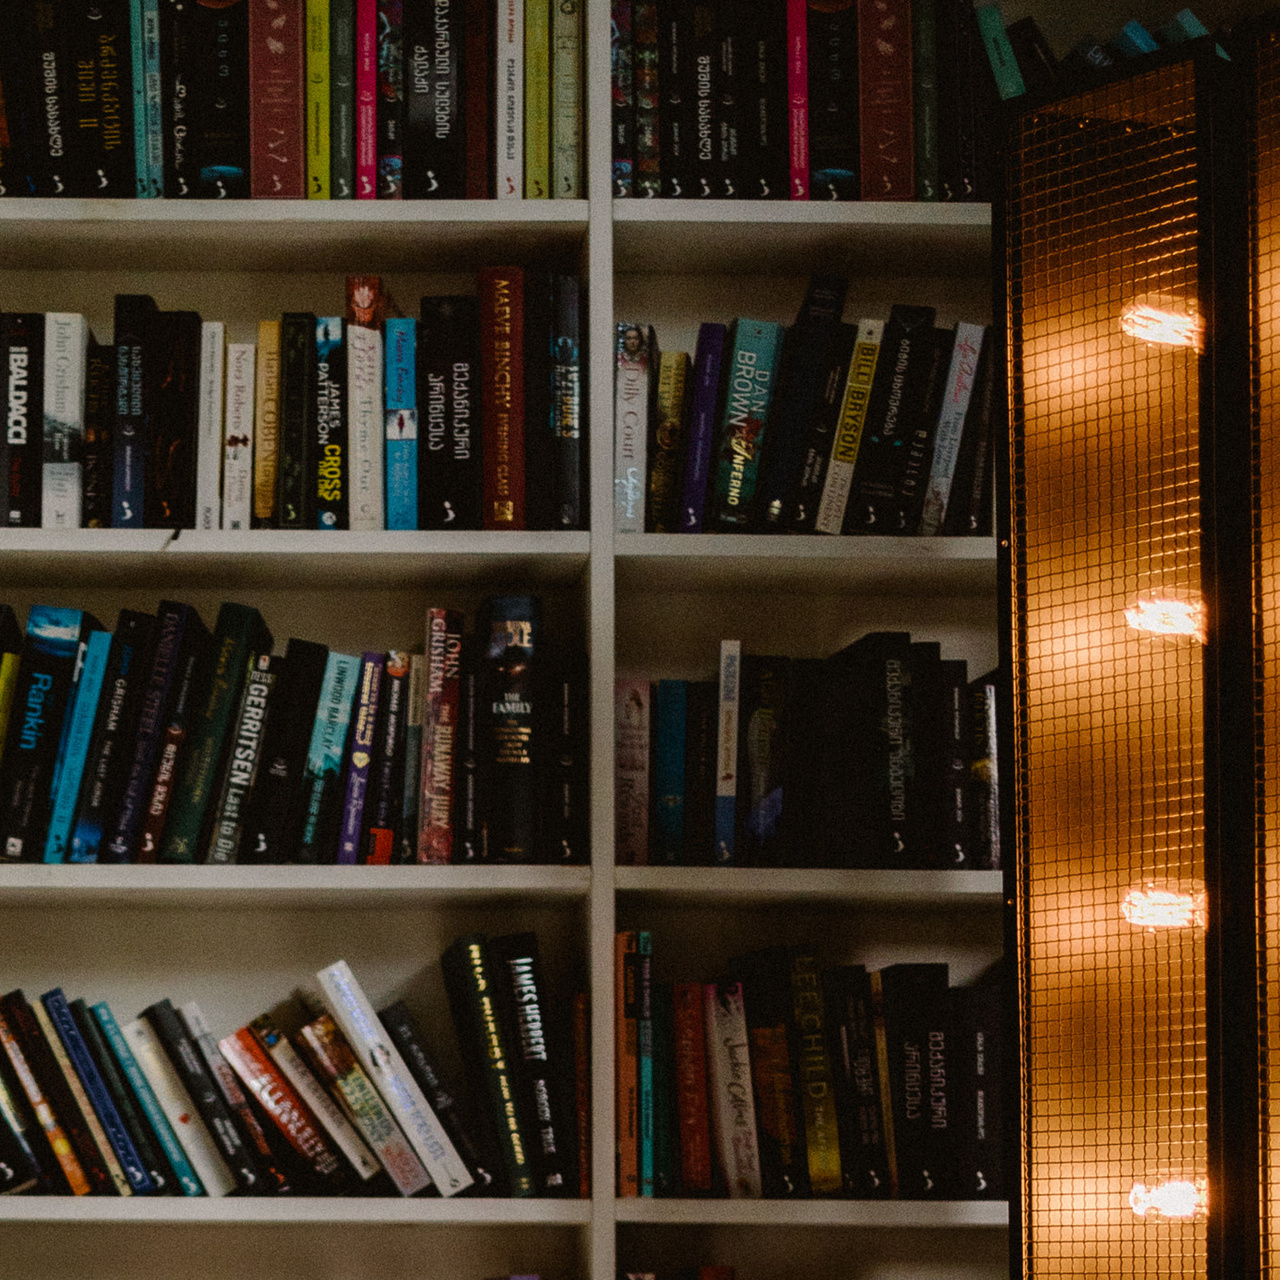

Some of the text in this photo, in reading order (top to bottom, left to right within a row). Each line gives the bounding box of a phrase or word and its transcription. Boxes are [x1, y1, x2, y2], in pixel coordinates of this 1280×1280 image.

[494, 279, 510, 333] MAEVE
[8, 353, 28, 445] BALDACCI
[54, 320, 71, 413] John Grisham
[231, 350, 247, 430] Nora Roberts
[317, 363, 329, 445] PATTERSON
[329, 382, 340, 428] JAMES
[494, 340, 511, 409] BINCHY
[729, 351, 756, 427] BROWN
[752, 370, 770, 412] DAN
[839, 346, 877, 457] BILL BRYSON
[453, 363, 470, 459] მექანიკური
[621, 369, 640, 459] Dilly Court
[324, 444, 341, 501] CROSS
[140, 613, 179, 734] DANIELLE STEEL
[430, 618, 446, 692] GRISHAM
[445, 634, 461, 678] JOHN
[20, 673, 52, 749] Rankin
[106, 678, 127, 731] GRISHAM
[322, 660, 349, 750] LINWOOD BARCLAY
[385, 679, 401, 757] MICHAEL MORPURGO
[214, 684, 269, 861] GERRITSEN Last to Die
[426, 705, 453, 829] THE RUNAWAY JURY
[507, 957, 548, 1061] JAMES HERBERT
[792, 957, 827, 1098] LEE CHILD
[723, 1037, 748, 1079] Jackie
